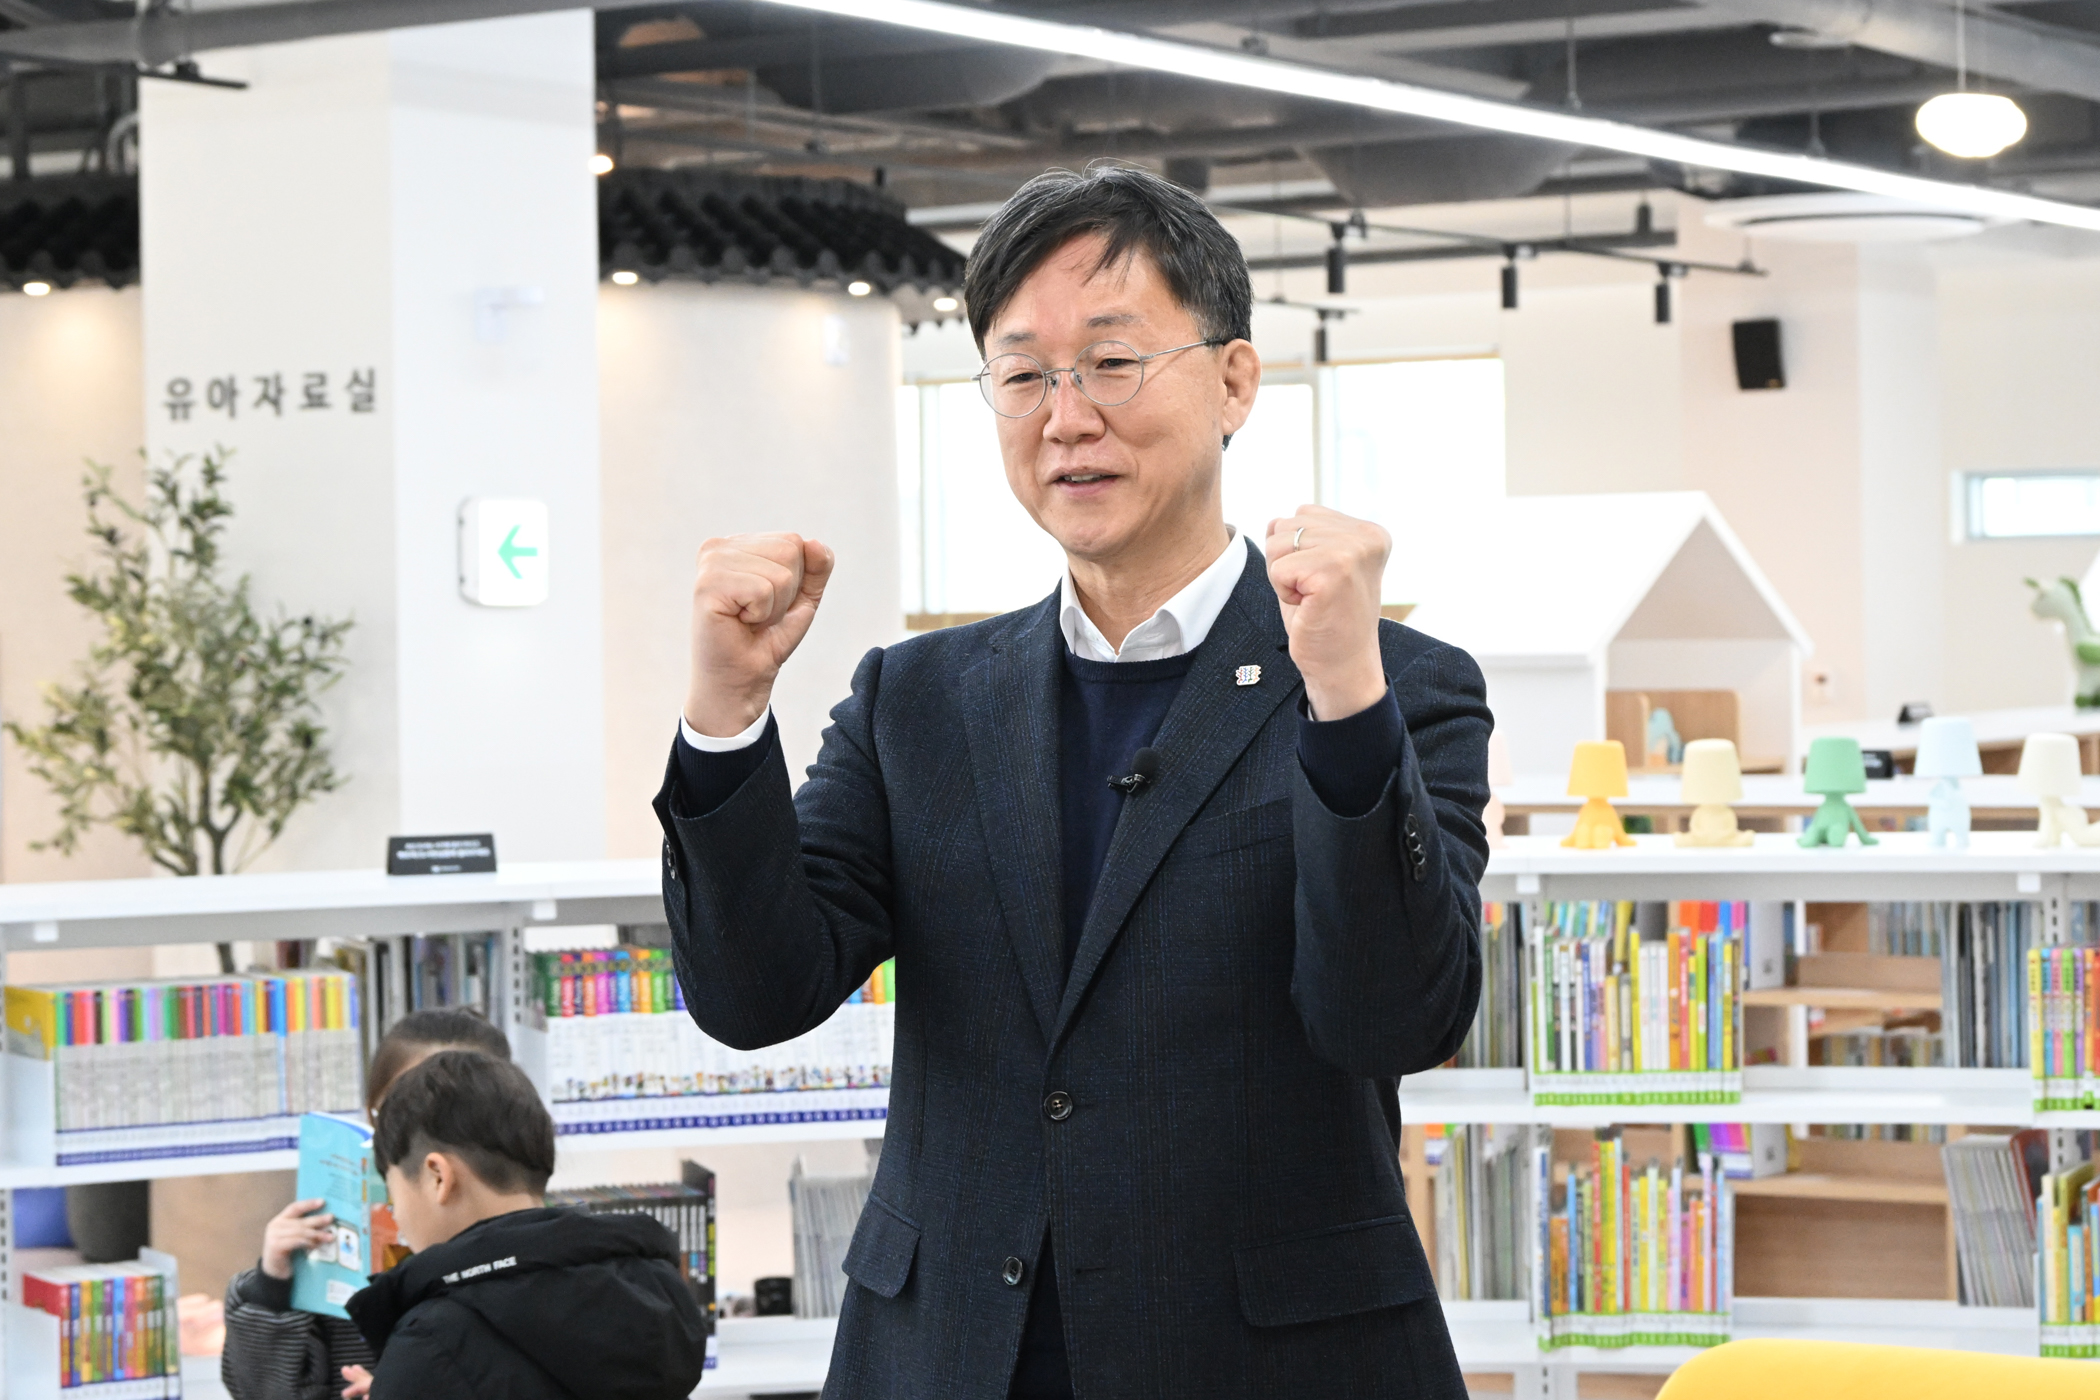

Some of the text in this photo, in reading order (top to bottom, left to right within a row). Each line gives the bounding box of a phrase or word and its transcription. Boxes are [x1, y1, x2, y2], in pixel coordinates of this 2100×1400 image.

[163, 367, 376, 421] 유아자료실
[442, 1256, 517, 1284] THE NORTH FACE
